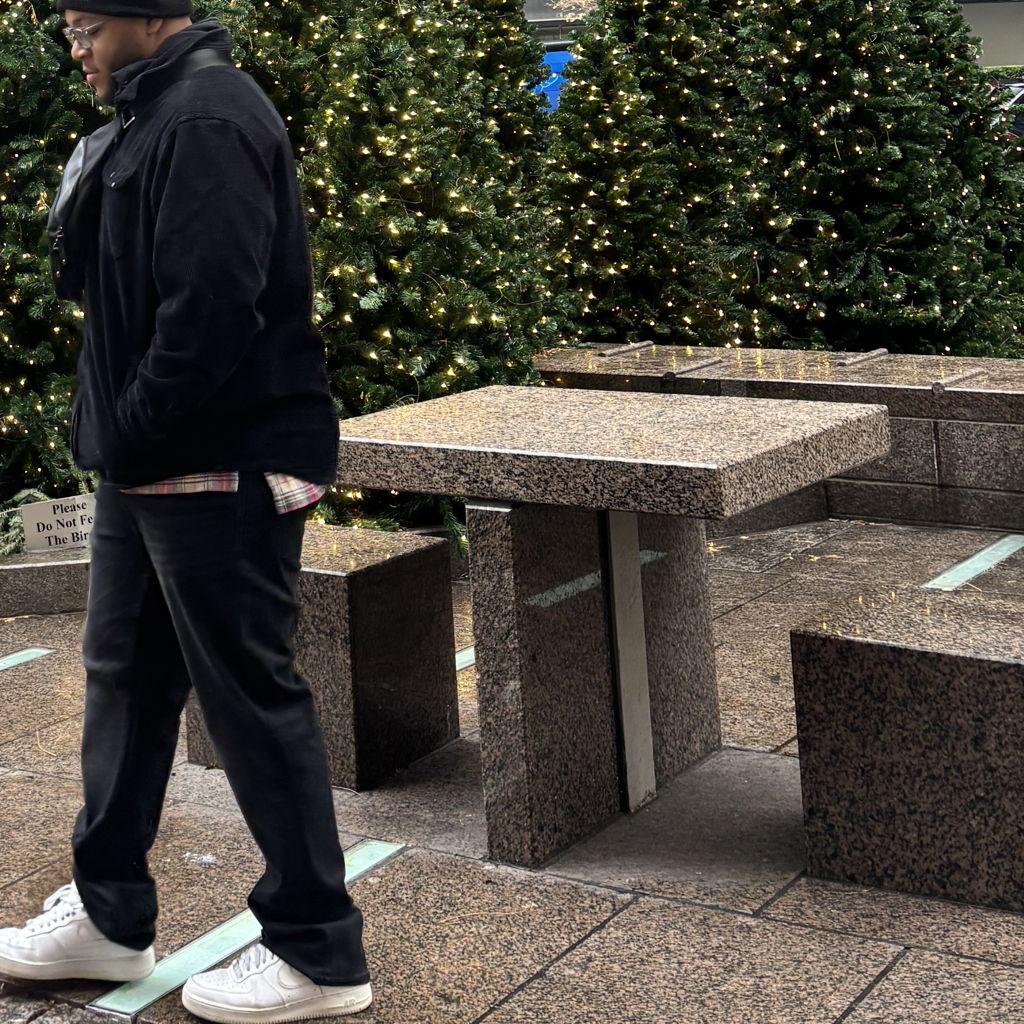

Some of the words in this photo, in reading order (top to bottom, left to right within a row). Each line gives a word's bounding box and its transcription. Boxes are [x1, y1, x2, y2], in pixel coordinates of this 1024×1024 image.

[52, 501, 87, 515] Please
[36, 521, 53, 533] Do
[56, 518, 77, 530] Not
[80, 514, 94, 526] Fe
[45, 535, 68, 547] The
[71, 530, 89, 543] Bir
